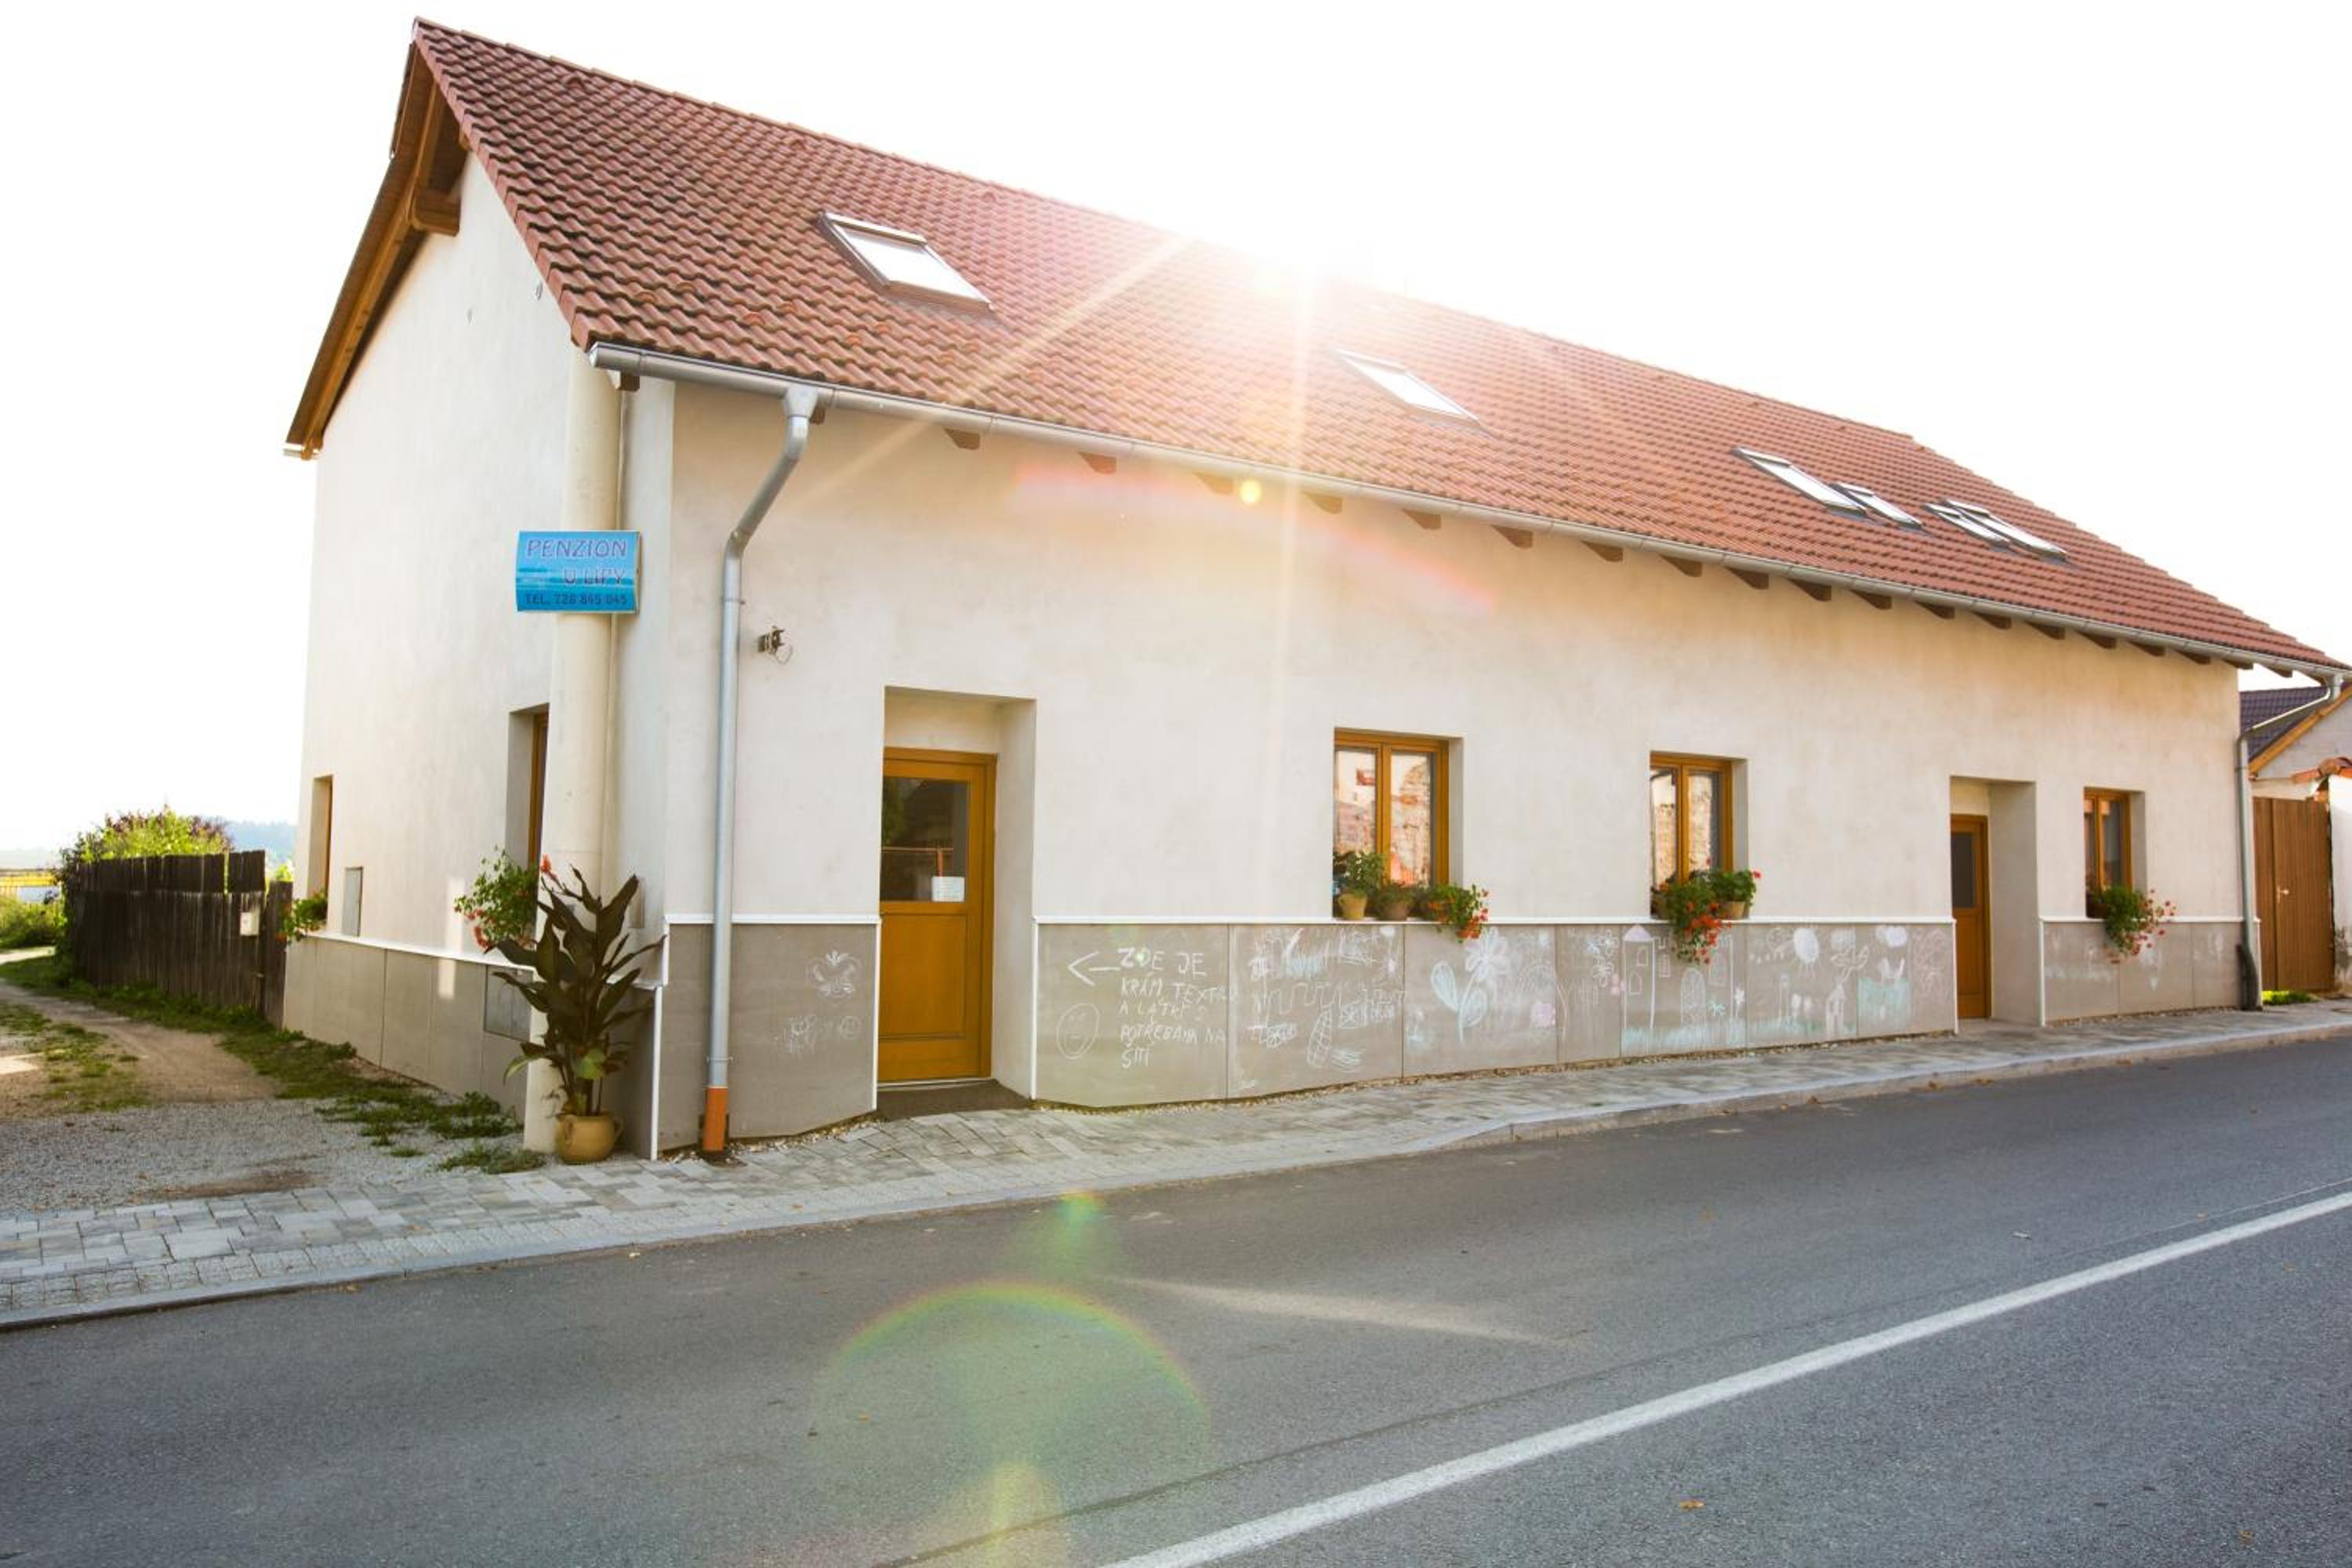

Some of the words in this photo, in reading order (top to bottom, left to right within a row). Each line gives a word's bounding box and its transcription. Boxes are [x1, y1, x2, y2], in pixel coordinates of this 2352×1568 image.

[527, 539, 626, 557] PENZION
[564, 568, 576, 584] U
[526, 593, 550, 604] TEL.
[1176, 951, 1207, 978] JE
[1118, 999, 1129, 1015] A
